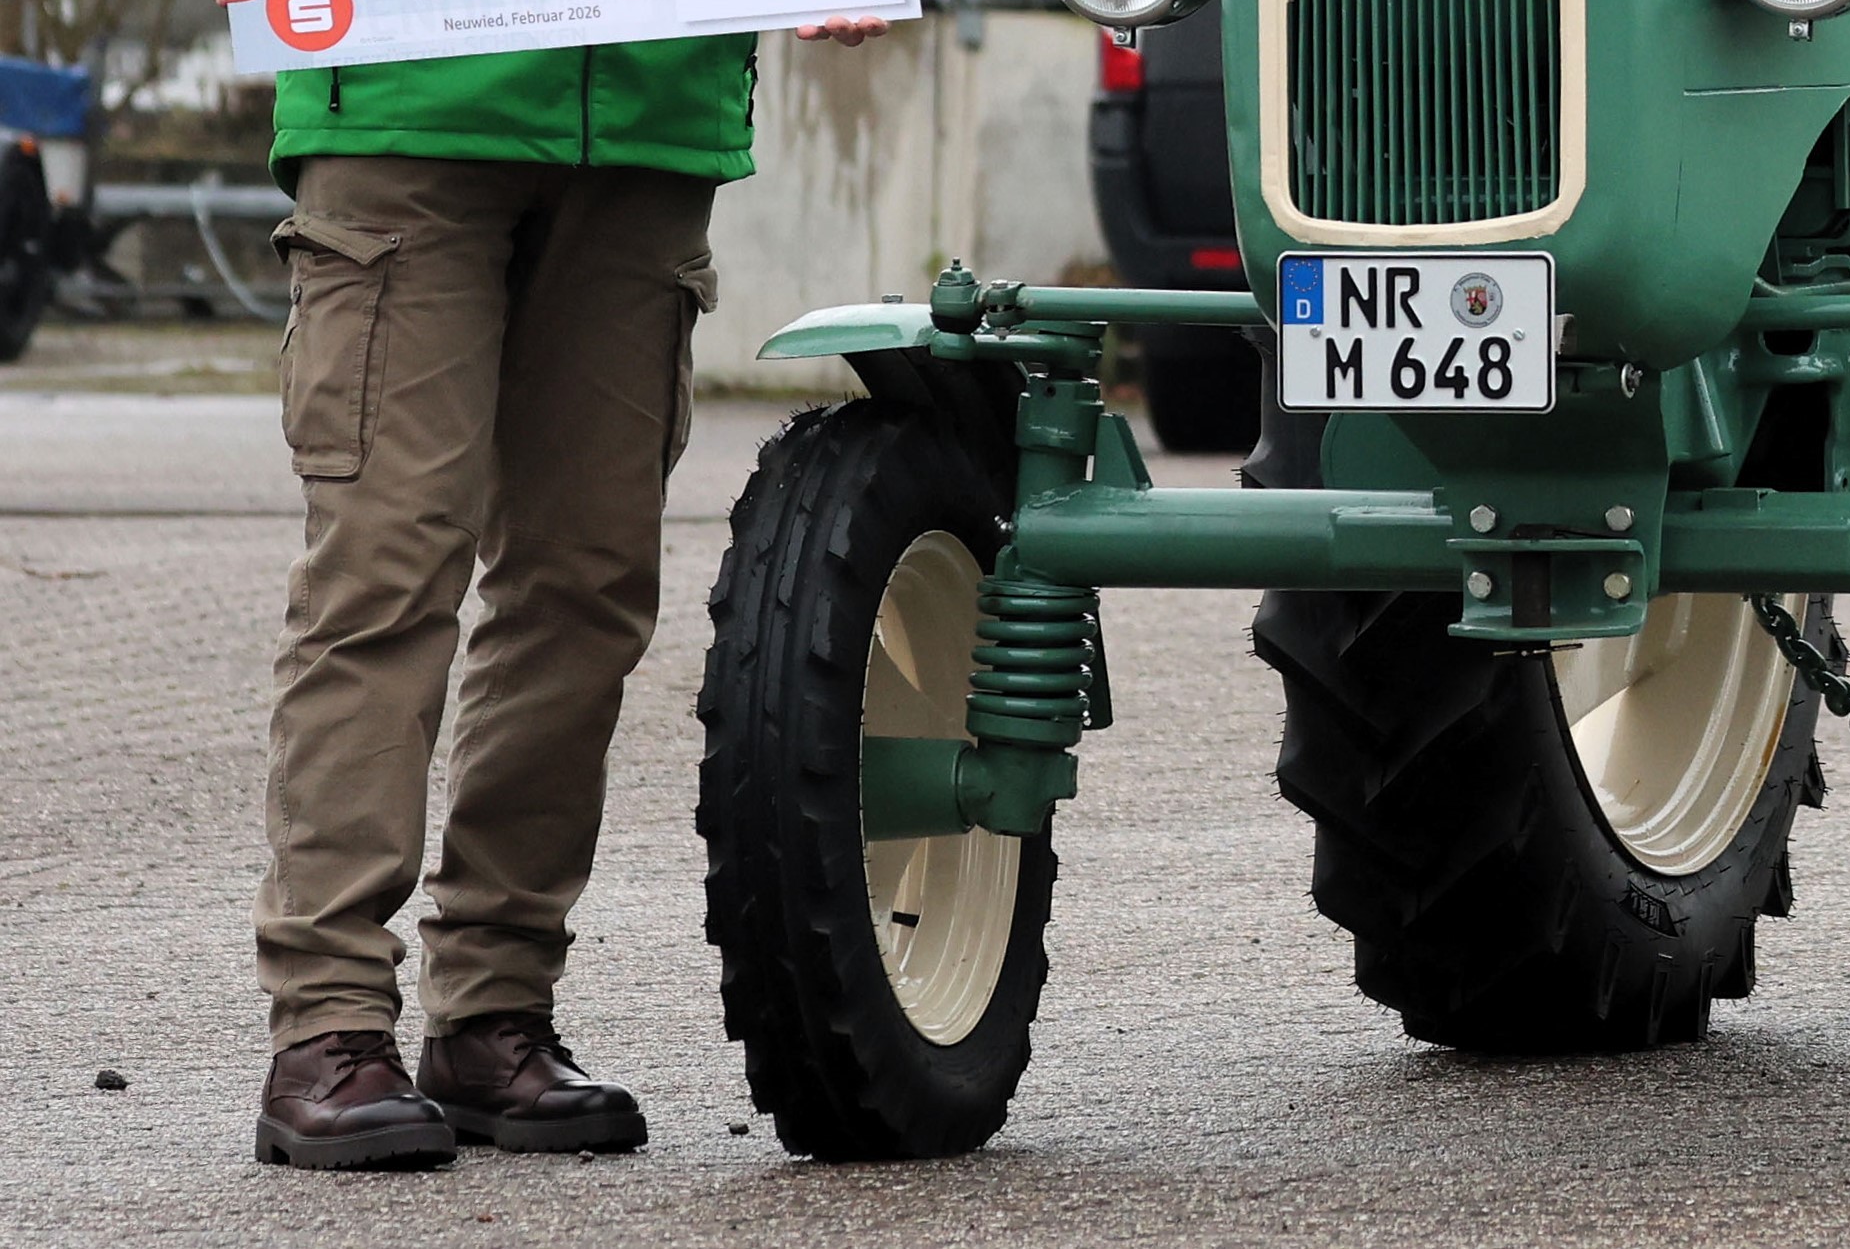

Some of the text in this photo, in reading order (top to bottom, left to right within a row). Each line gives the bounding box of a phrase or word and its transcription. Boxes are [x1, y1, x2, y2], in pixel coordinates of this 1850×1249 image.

[442, 12, 510, 32] Neuwied,
[511, 8, 567, 27] Februar
[570, 4, 602, 21] 2026
[1296, 298, 1312, 319] D
[1340, 266, 1423, 328] NR
[1325, 336, 1514, 400] M 648
